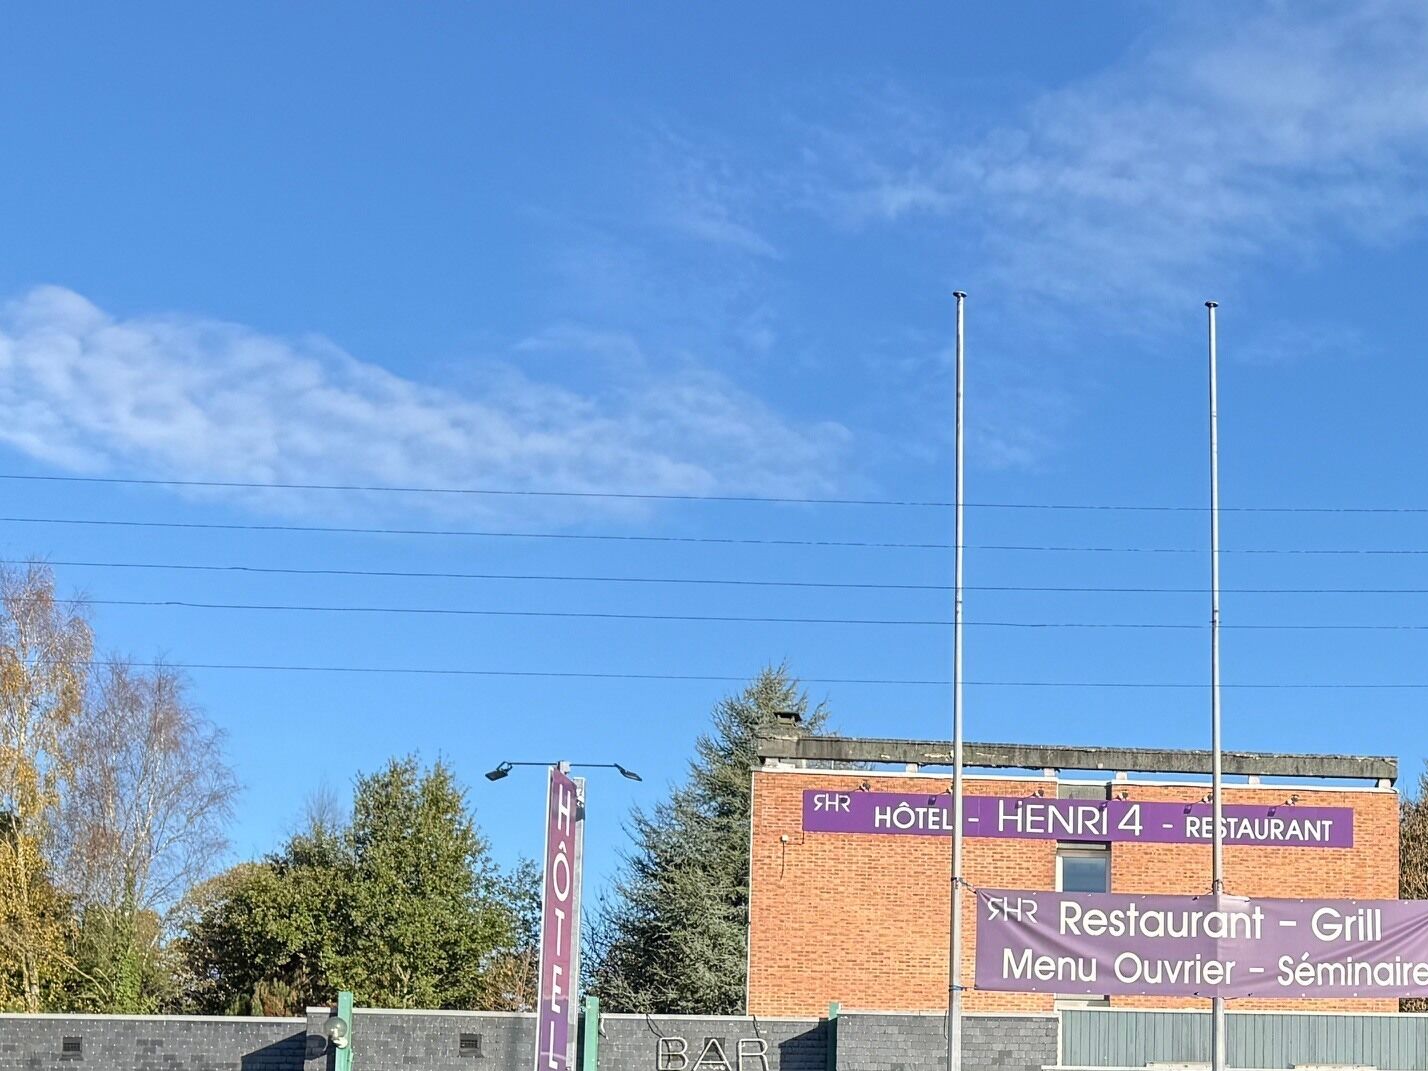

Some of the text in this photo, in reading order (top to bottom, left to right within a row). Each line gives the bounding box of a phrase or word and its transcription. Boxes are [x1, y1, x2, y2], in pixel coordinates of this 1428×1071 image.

[874, 802, 953, 830] HÔTEL
[998, 800, 1107, 835] HENRI
[1117, 804, 1143, 836] 4
[548, 783, 571, 1070] HÔTEL
[1060, 901, 1265, 940] Restaurant
[1311, 907, 1382, 942] Grill
[1002, 949, 1097, 982] Menu
[1114, 952, 1236, 985] Ouvrier
